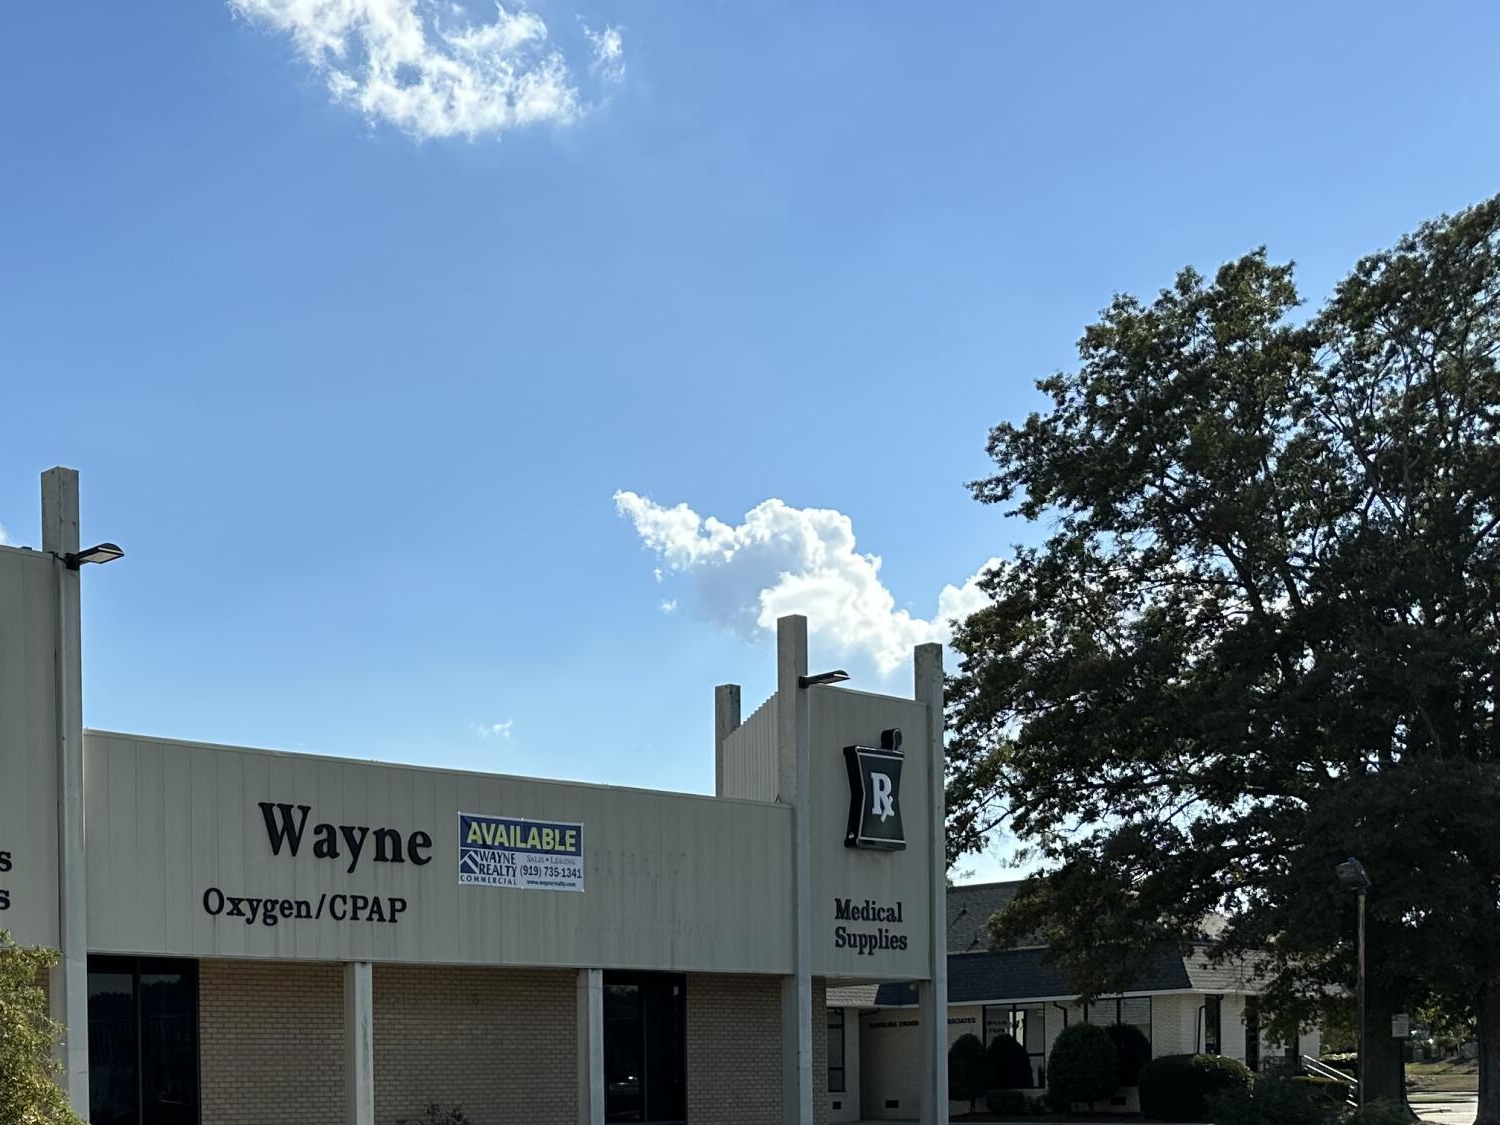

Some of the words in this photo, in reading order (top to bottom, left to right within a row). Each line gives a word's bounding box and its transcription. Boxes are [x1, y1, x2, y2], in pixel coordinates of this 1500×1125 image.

[259, 802, 433, 874] Wayne
[467, 821, 577, 852] AVAILABLE
[479, 850, 517, 865] WAYNE
[460, 874, 517, 885] COMMERCIAL
[479, 863, 518, 878] REALTY
[519, 865, 542, 878] (919)
[544, 866, 582, 879] 735-1341
[202, 887, 408, 927] Oxygen/CPAP
[834, 898, 903, 923] Medical
[835, 927, 907, 956] Supplies
